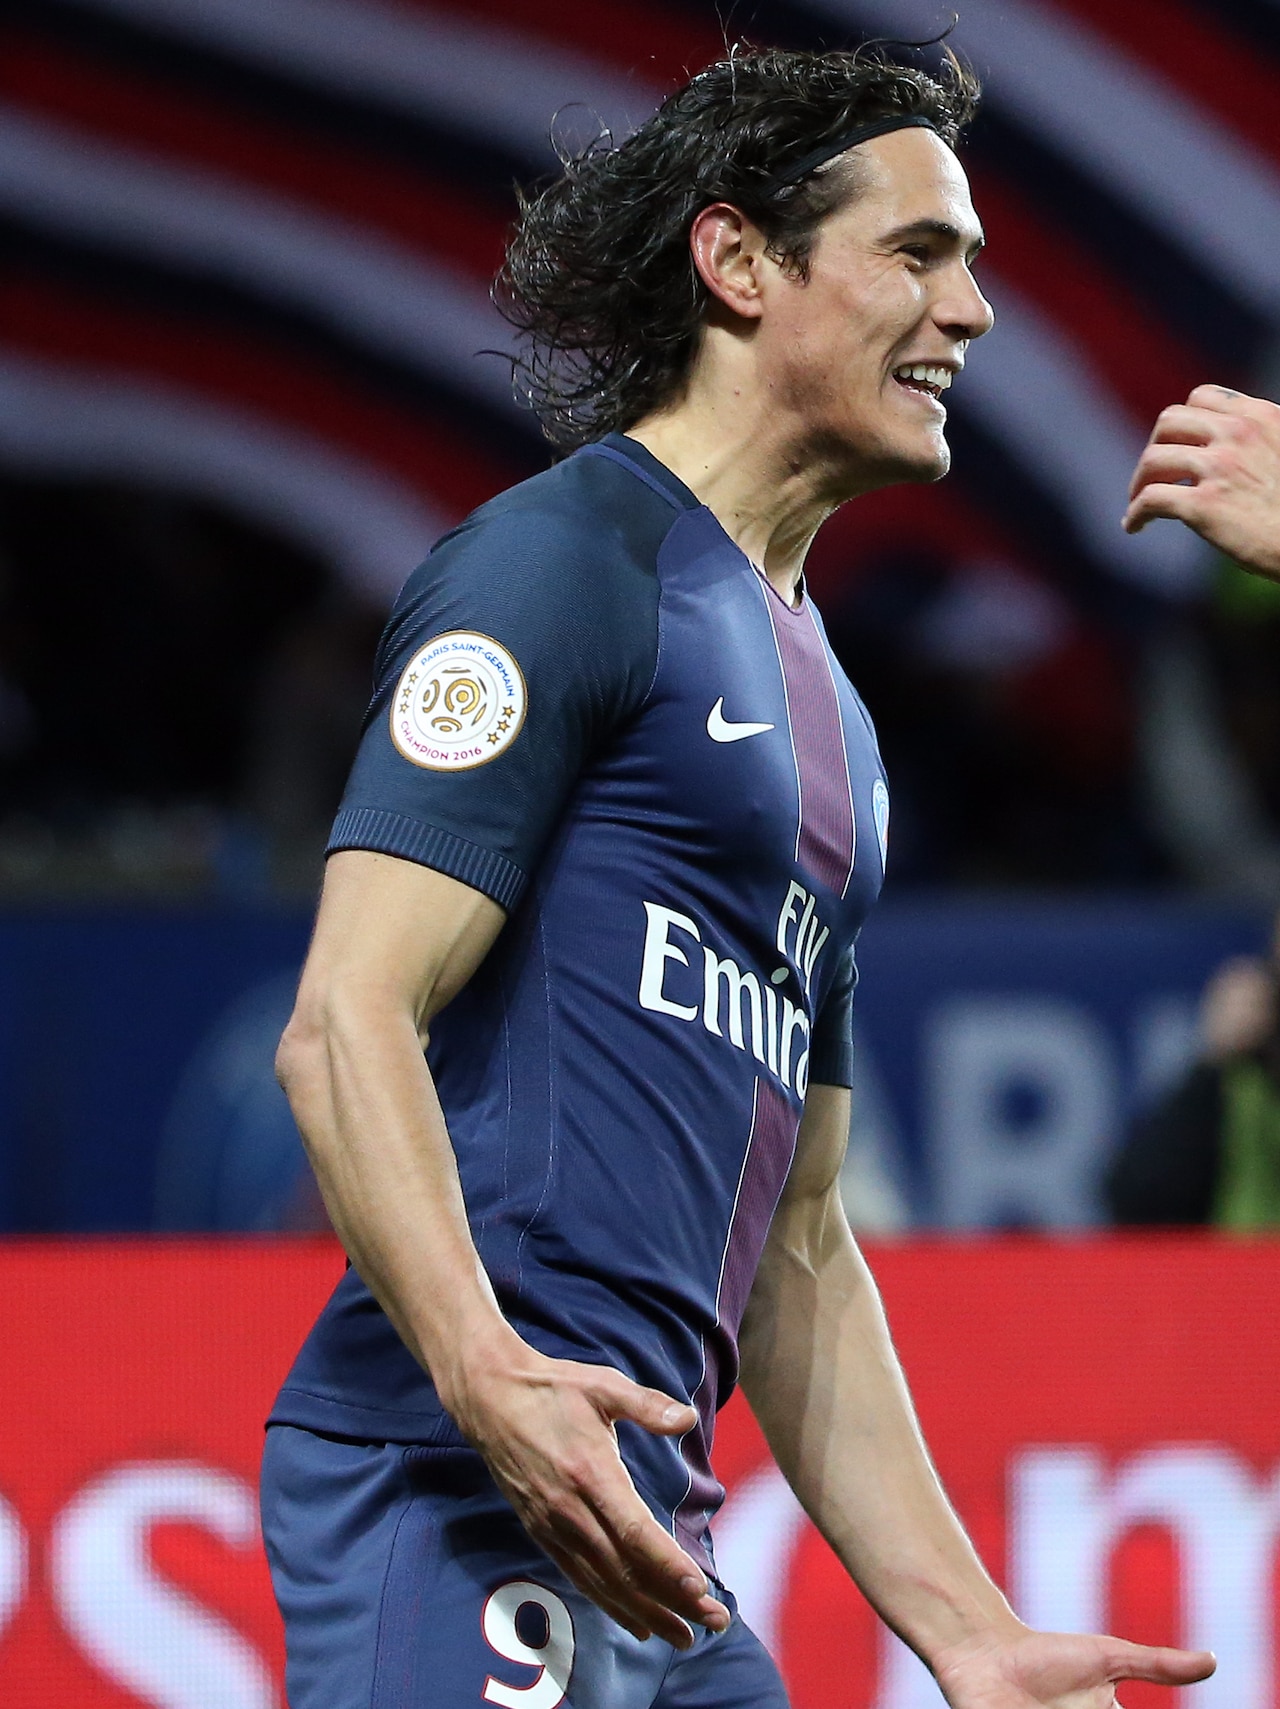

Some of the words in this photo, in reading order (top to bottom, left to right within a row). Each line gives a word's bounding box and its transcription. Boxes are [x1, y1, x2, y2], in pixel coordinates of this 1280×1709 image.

[420, 644, 450, 666] PARIS
[451, 642, 516, 697] SAINT-GERMAIN
[400, 720, 449, 760] CHAMPION
[453, 746, 483, 760] 2016
[777, 879, 831, 996] Fly
[480, 1579, 577, 1709] 9
